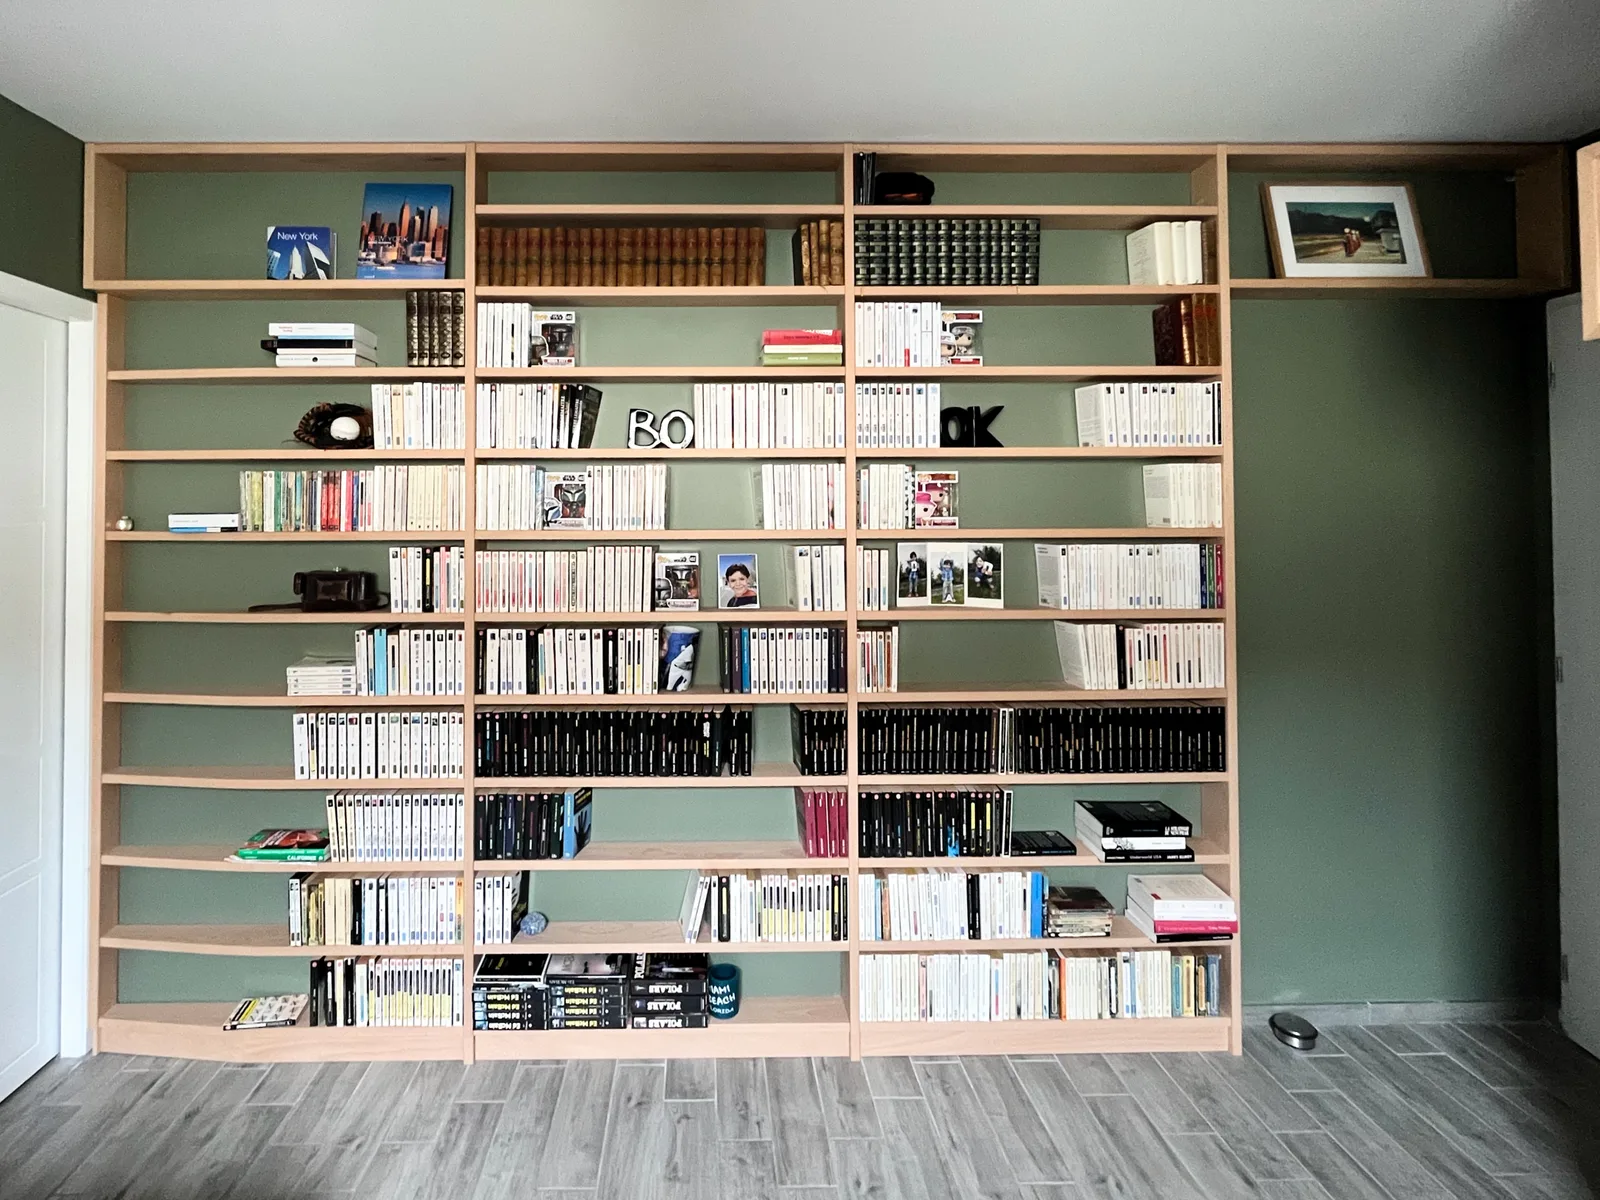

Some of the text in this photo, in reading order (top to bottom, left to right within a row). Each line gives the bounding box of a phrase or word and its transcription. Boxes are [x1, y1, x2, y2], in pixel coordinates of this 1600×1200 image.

[277, 231, 319, 240] New York
[648, 984, 683, 994] POLARS
[646, 1001, 682, 1010] POLARS
[710, 1005, 734, 1014] LORIDA
[648, 1018, 682, 1028] POLARS
